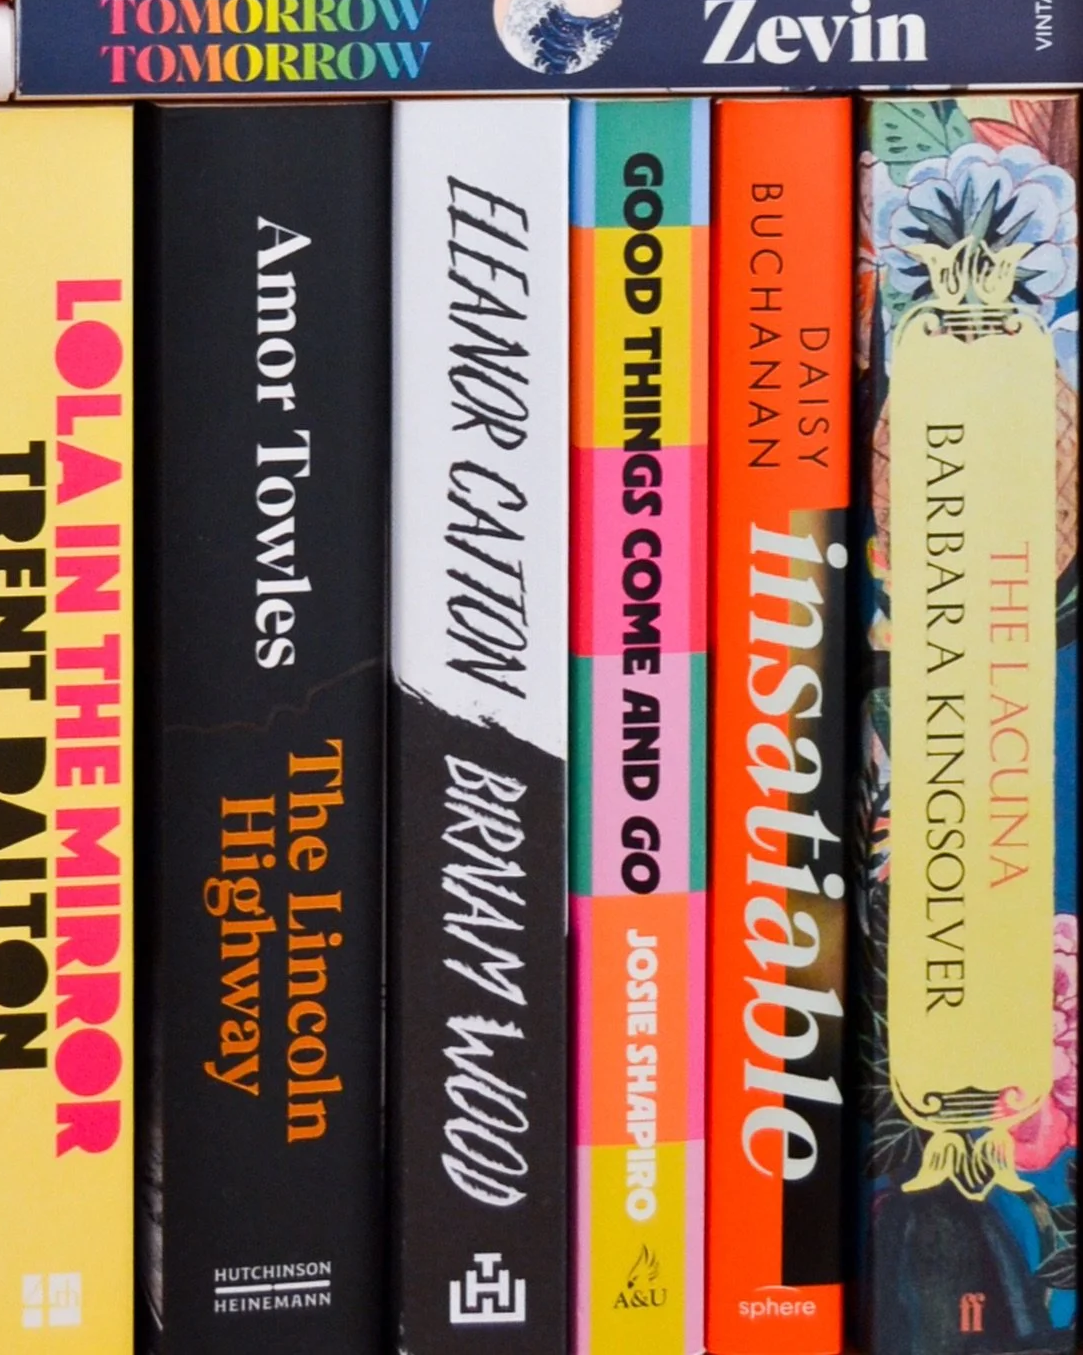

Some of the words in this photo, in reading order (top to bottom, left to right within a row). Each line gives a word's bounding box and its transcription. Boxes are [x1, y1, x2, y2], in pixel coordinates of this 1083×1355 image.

[99, 41, 432, 83] TOMORROW
[256, 214, 312, 410] Amor
[446, 174, 530, 453] ELEANOR
[622, 152, 664, 315] GOOD
[749, 182, 783, 470] BUCHANAN
[55, 278, 123, 505] LOLA
[622, 326, 664, 517] THINGS
[798, 326, 830, 470] DAISY
[55, 523, 123, 615] IN
[256, 427, 312, 670] Towles
[444, 456, 529, 700] CATTON
[622, 526, 664, 675] COME
[926, 421, 965, 675] BARBARA
[988, 540, 1032, 643] THE
[55, 632, 123, 788] THE
[622, 688, 662, 800] AND
[988, 660, 1030, 890] LACUNA
[287, 739, 345, 873] The
[442, 753, 528, 1006] BIRNAM
[621, 815, 662, 894] GO
[741, 521, 848, 1181] insatiable
[925, 687, 965, 1014] KINGSOLVER
[55, 805, 123, 1158] MIRROR
[204, 794, 277, 1098] Highway
[287, 890, 344, 1144] Lincoln
[625, 928, 658, 1036] JOSIE
[441, 1013, 529, 1208] WOOD
[624, 1043, 657, 1222] SHAPIRO
[213, 1292, 332, 1313] HEINEMANN
[214, 1261, 332, 1281] HUTCHINSON
[613, 1289, 667, 1308] A&U
[738, 1296, 816, 1317] sphere
